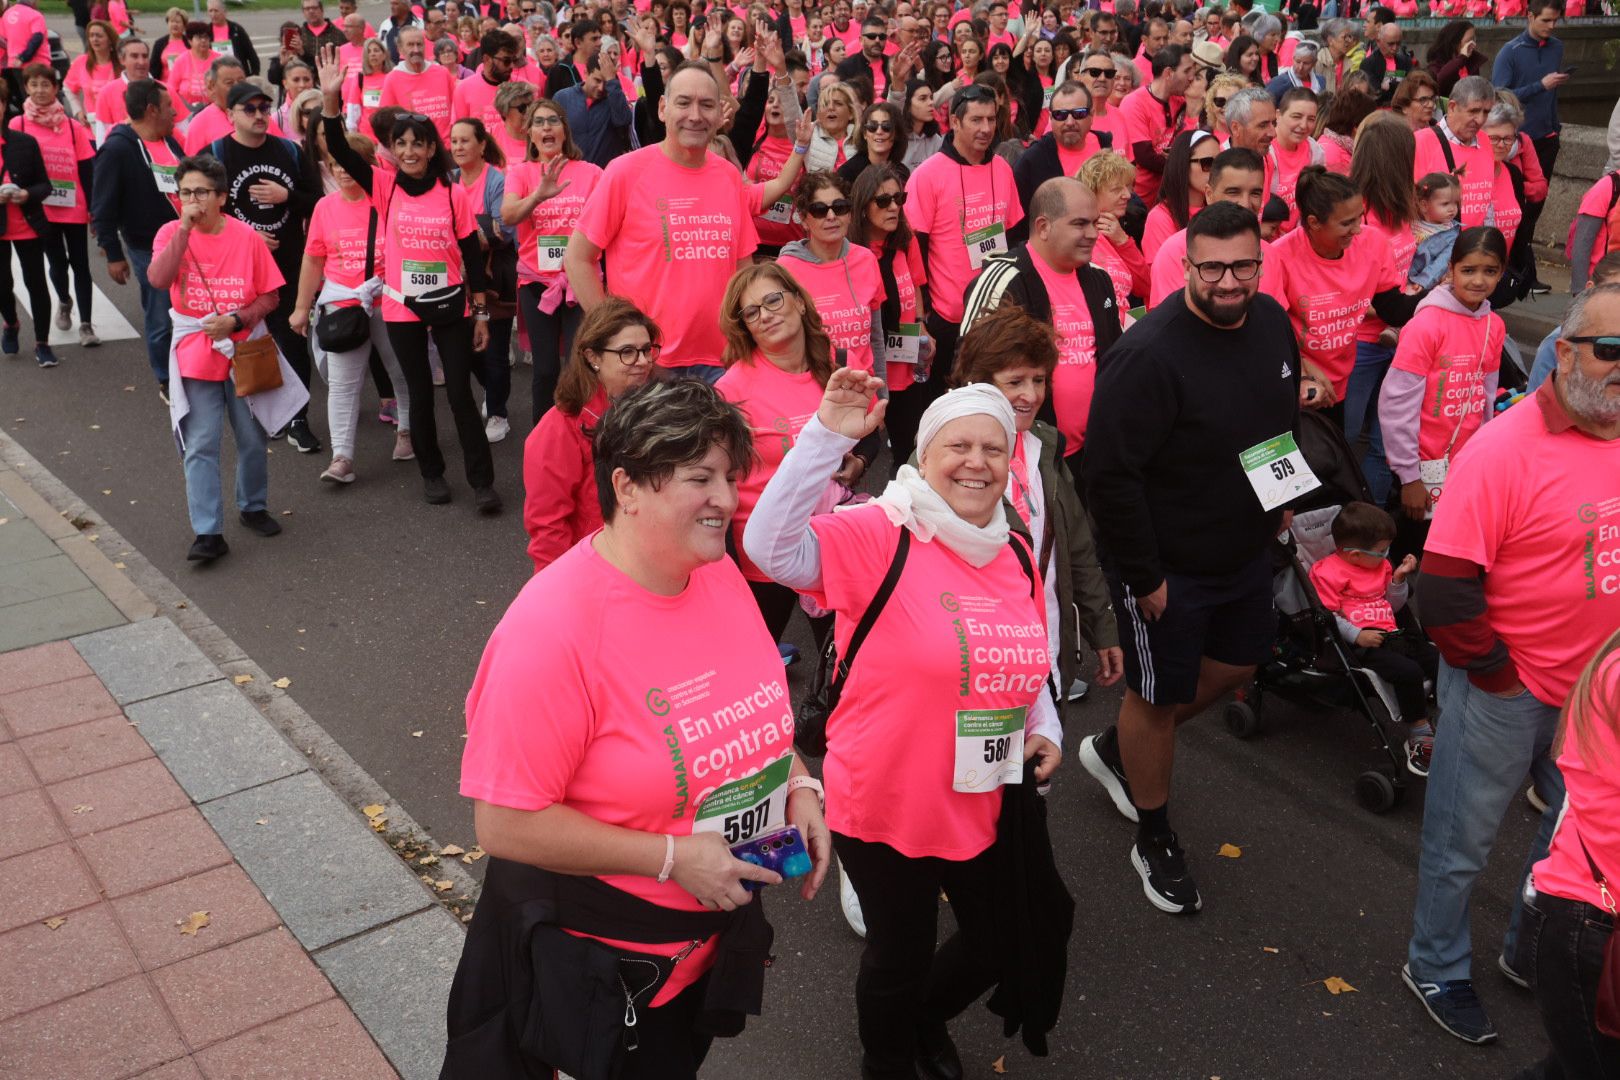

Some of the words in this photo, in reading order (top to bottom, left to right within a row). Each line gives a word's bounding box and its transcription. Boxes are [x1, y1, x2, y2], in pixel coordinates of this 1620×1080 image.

[230, 164, 282, 200] JACK&JONES
[533, 206, 571, 217] contra
[669, 213, 686, 225] En
[689, 211, 733, 225] marcha
[399, 224, 440, 237] contra
[672, 227, 719, 242] contra
[980, 238, 997, 254] 808
[411, 274, 439, 285] 5380
[231, 288, 244, 299] el
[1309, 309, 1326, 321] En
[1328, 297, 1371, 319] marcha
[1308, 317, 1356, 337] contra
[887, 336, 903, 349] 04
[1448, 370, 1463, 382] En
[1270, 457, 1296, 481] 579
[1598, 524, 1619, 543] En
[966, 618, 993, 637] En
[973, 643, 1048, 665] contra
[678, 716, 709, 744] En
[713, 680, 784, 730] marcha
[693, 721, 779, 780] contra
[984, 736, 1011, 763] 580
[724, 798, 771, 844] 5977
